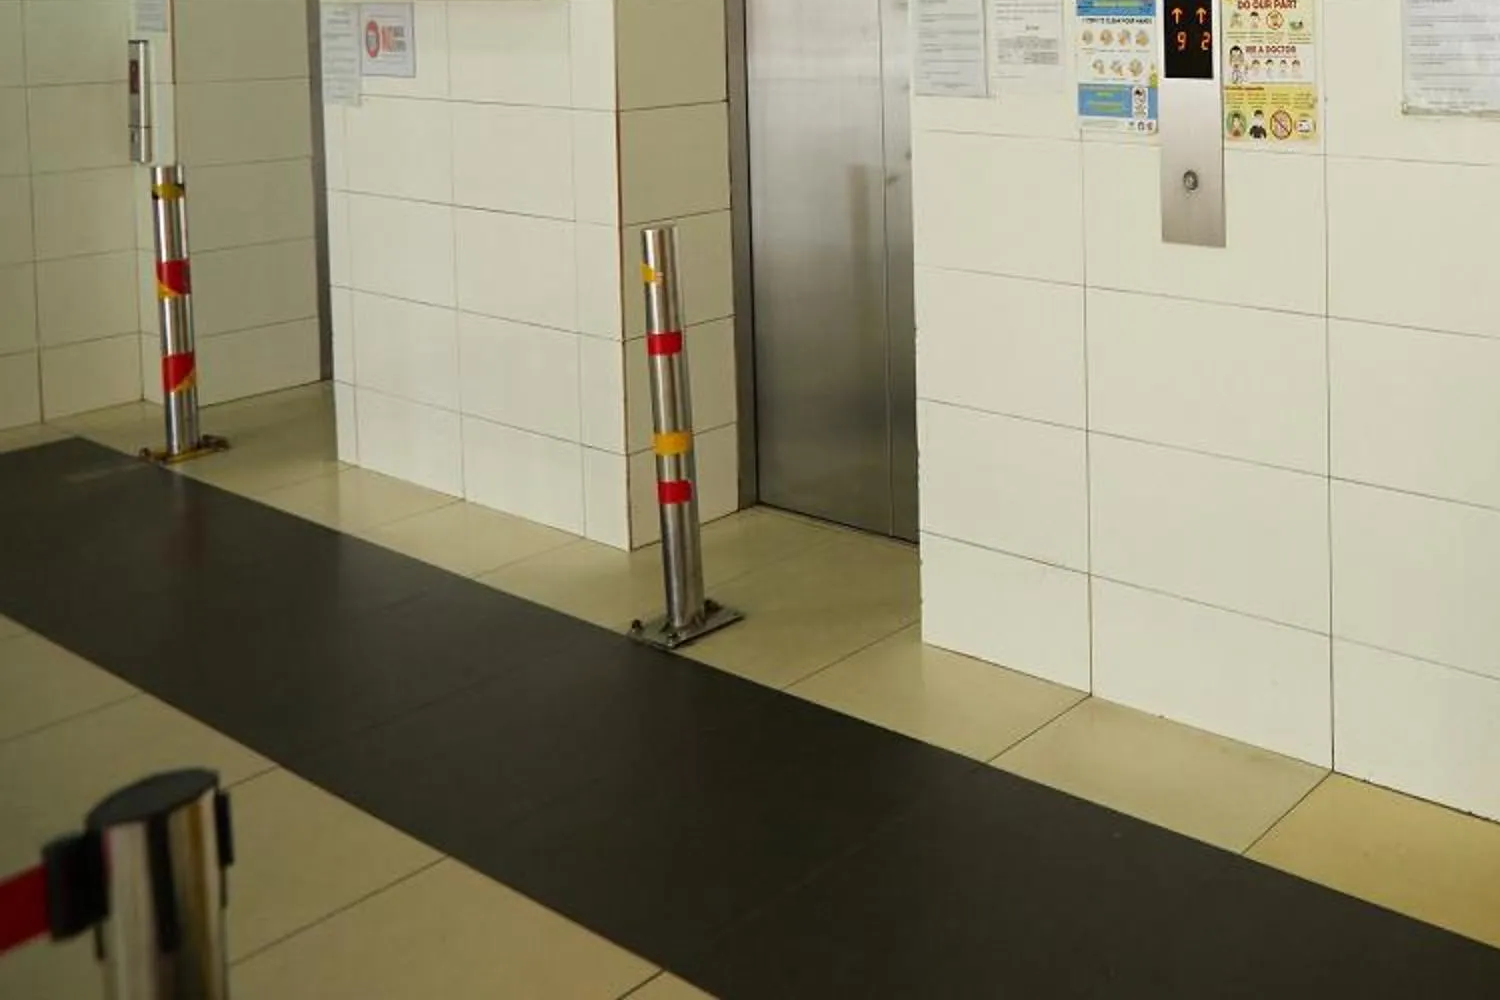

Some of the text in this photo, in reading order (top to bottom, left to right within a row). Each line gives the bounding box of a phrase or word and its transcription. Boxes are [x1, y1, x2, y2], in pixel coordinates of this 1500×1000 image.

[1274, 0, 1297, 9] PART
[1176, 31, 1186, 50] 9
[1200, 31, 1210, 50] 2
